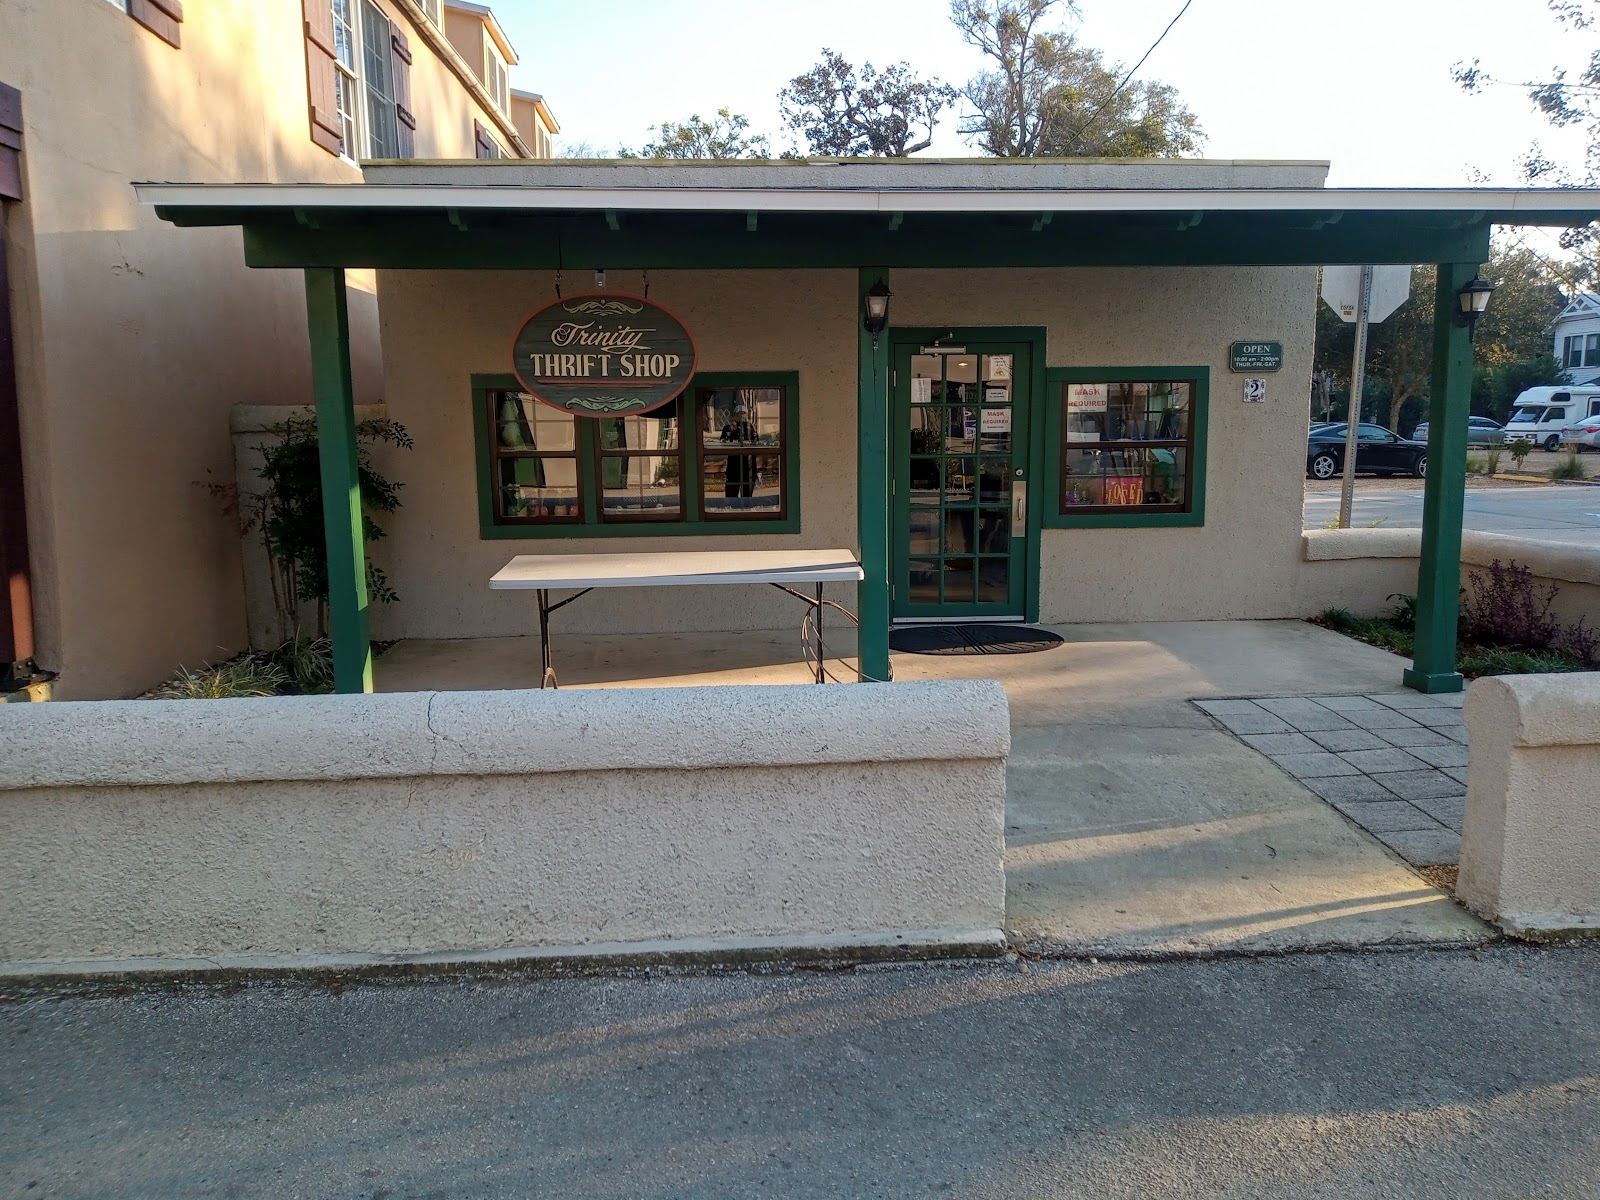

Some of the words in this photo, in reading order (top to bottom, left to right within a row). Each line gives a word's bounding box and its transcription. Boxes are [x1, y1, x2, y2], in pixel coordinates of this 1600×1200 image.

[551, 321, 656, 354] Trinity
[1243, 345, 1271, 353] OPEN
[530, 354, 612, 377] THRIFT
[620, 354, 680, 377] SHOP
[1250, 382, 1259, 397] 2
[1106, 484, 1143, 504] LOSED
